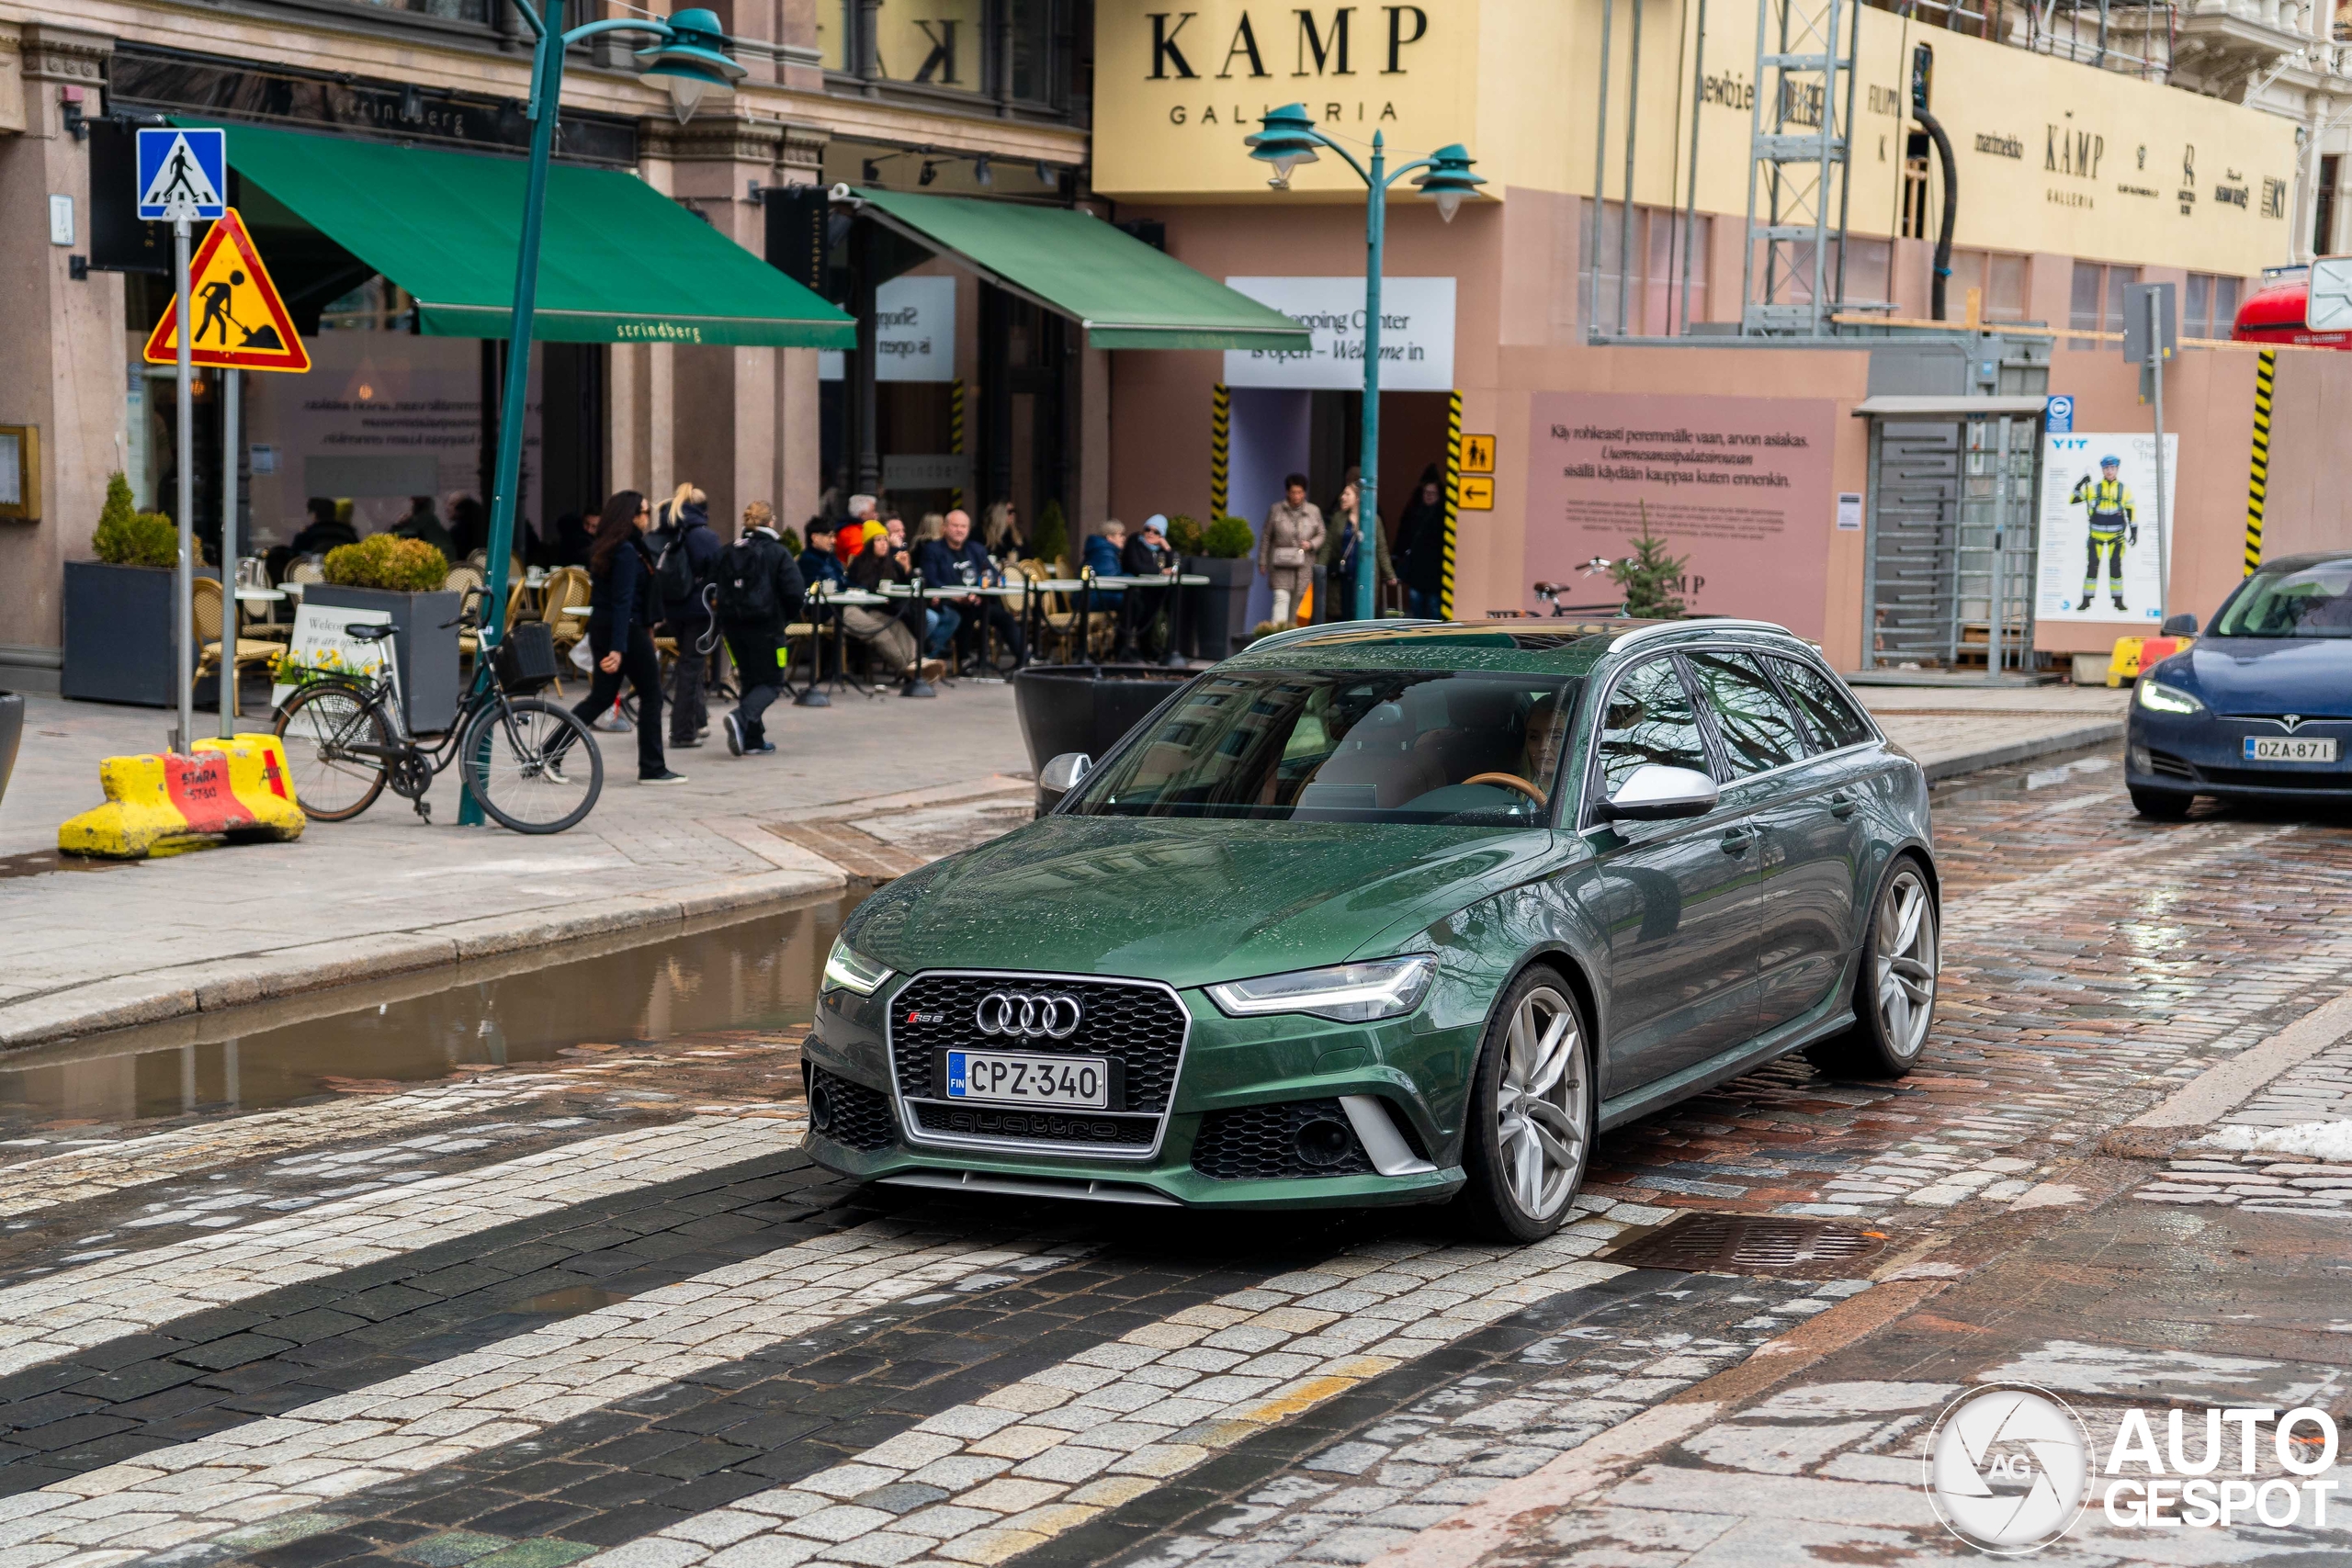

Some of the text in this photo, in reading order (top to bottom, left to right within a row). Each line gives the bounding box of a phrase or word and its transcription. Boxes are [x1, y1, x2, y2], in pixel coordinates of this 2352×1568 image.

[1700, 68, 1755, 110] ewbie
[1351, 308, 1411, 330] Cnter
[616, 321, 702, 344] strindberg
[1408, 341, 1424, 361] in
[1550, 423, 1570, 443] Käy
[1572, 424, 1624, 441] rohkeasti
[1625, 427, 1693, 445] peremmälle
[1727, 434, 1762, 446] arvon
[2052, 438, 2088, 451] YIT
[1564, 463, 1596, 479] sisällä
[1598, 463, 1644, 483] käydään
[1645, 466, 1694, 486] kauppaa
[1696, 468, 1730, 485] kuten
[2258, 741, 2328, 759] OZA-871
[182, 770, 218, 785] STARA
[950, 1060, 1097, 1100] FIN CPZ-340
[950, 1111, 1118, 1137] quattro
